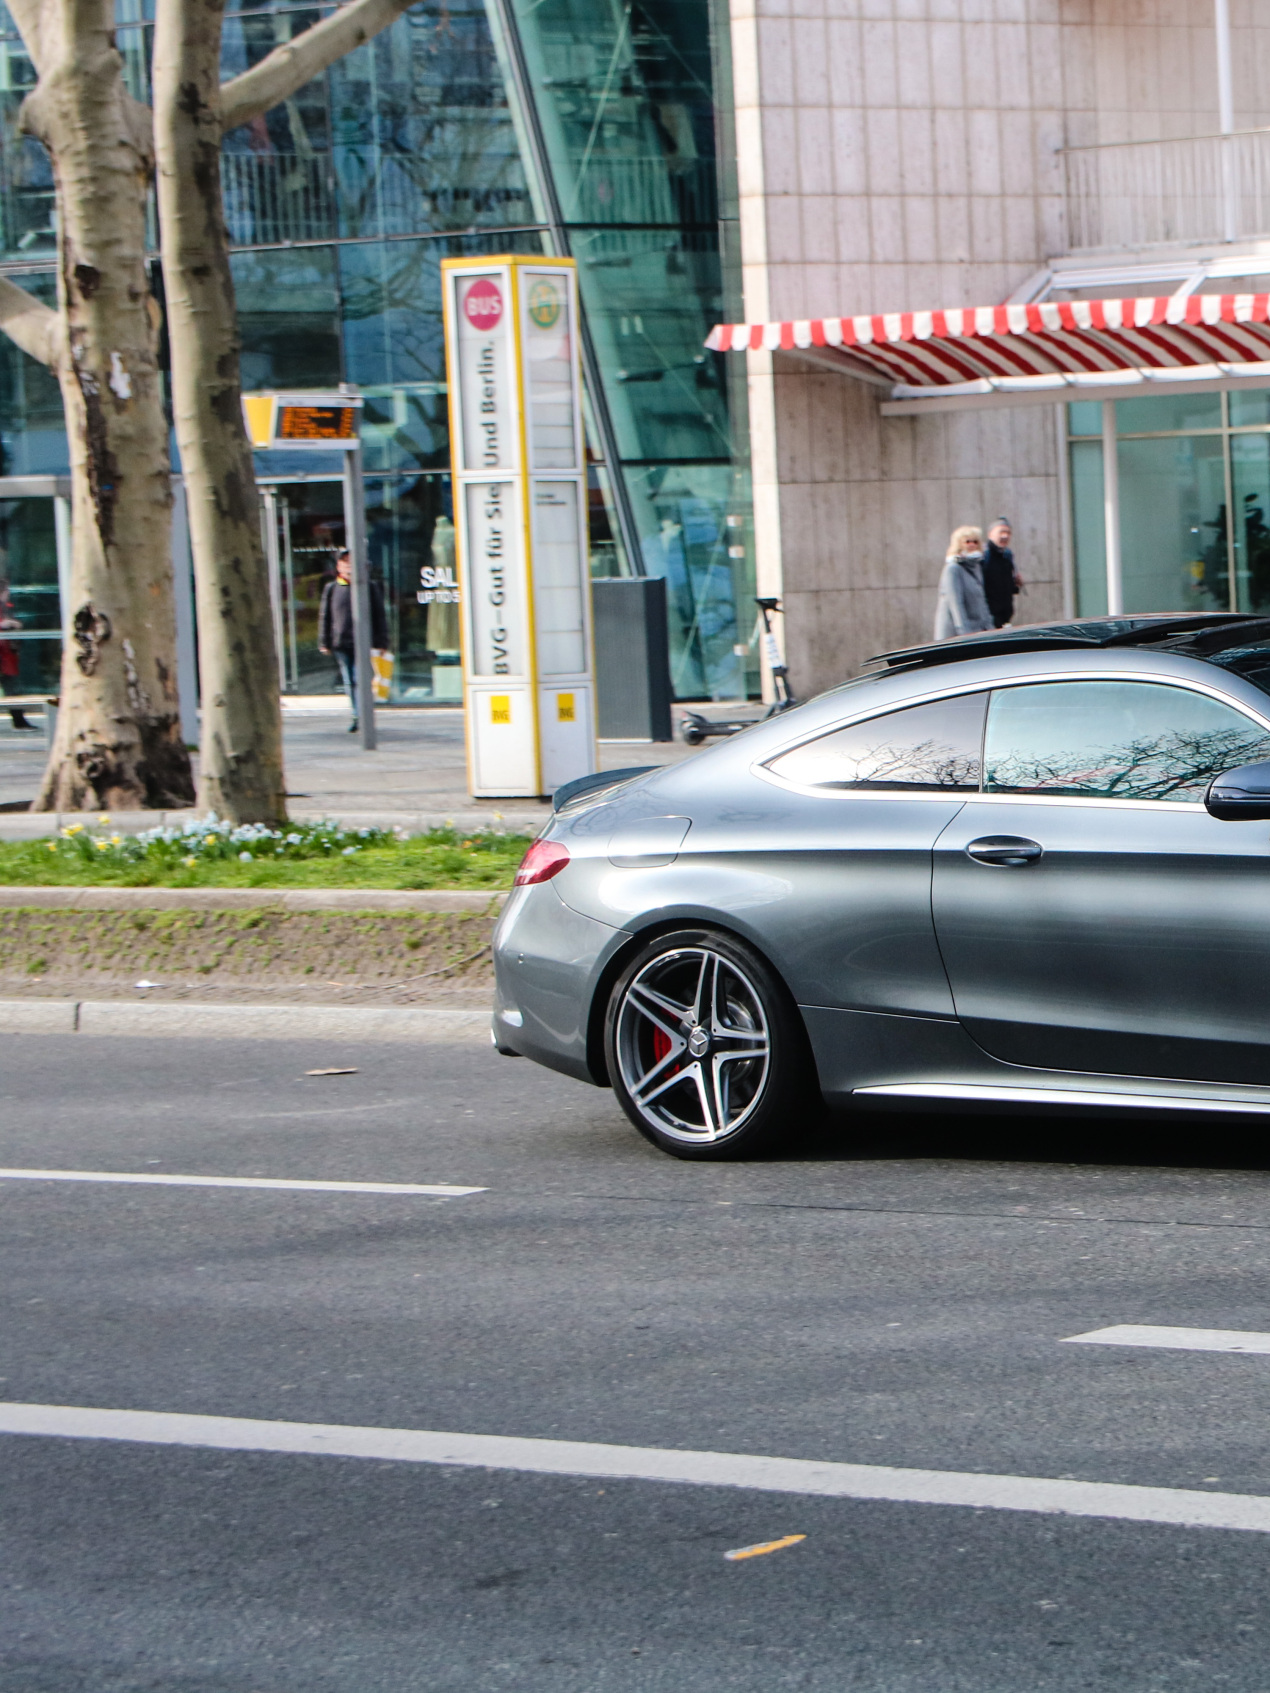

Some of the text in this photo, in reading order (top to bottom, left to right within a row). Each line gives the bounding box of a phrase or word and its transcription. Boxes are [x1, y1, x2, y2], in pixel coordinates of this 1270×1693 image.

[467, 296, 501, 316] BUS
[477, 340, 497, 414] Berlin.
[480, 421, 499, 467] Und
[484, 484, 503, 520] Sie
[486, 527, 503, 558] für
[416, 590, 435, 604] UP
